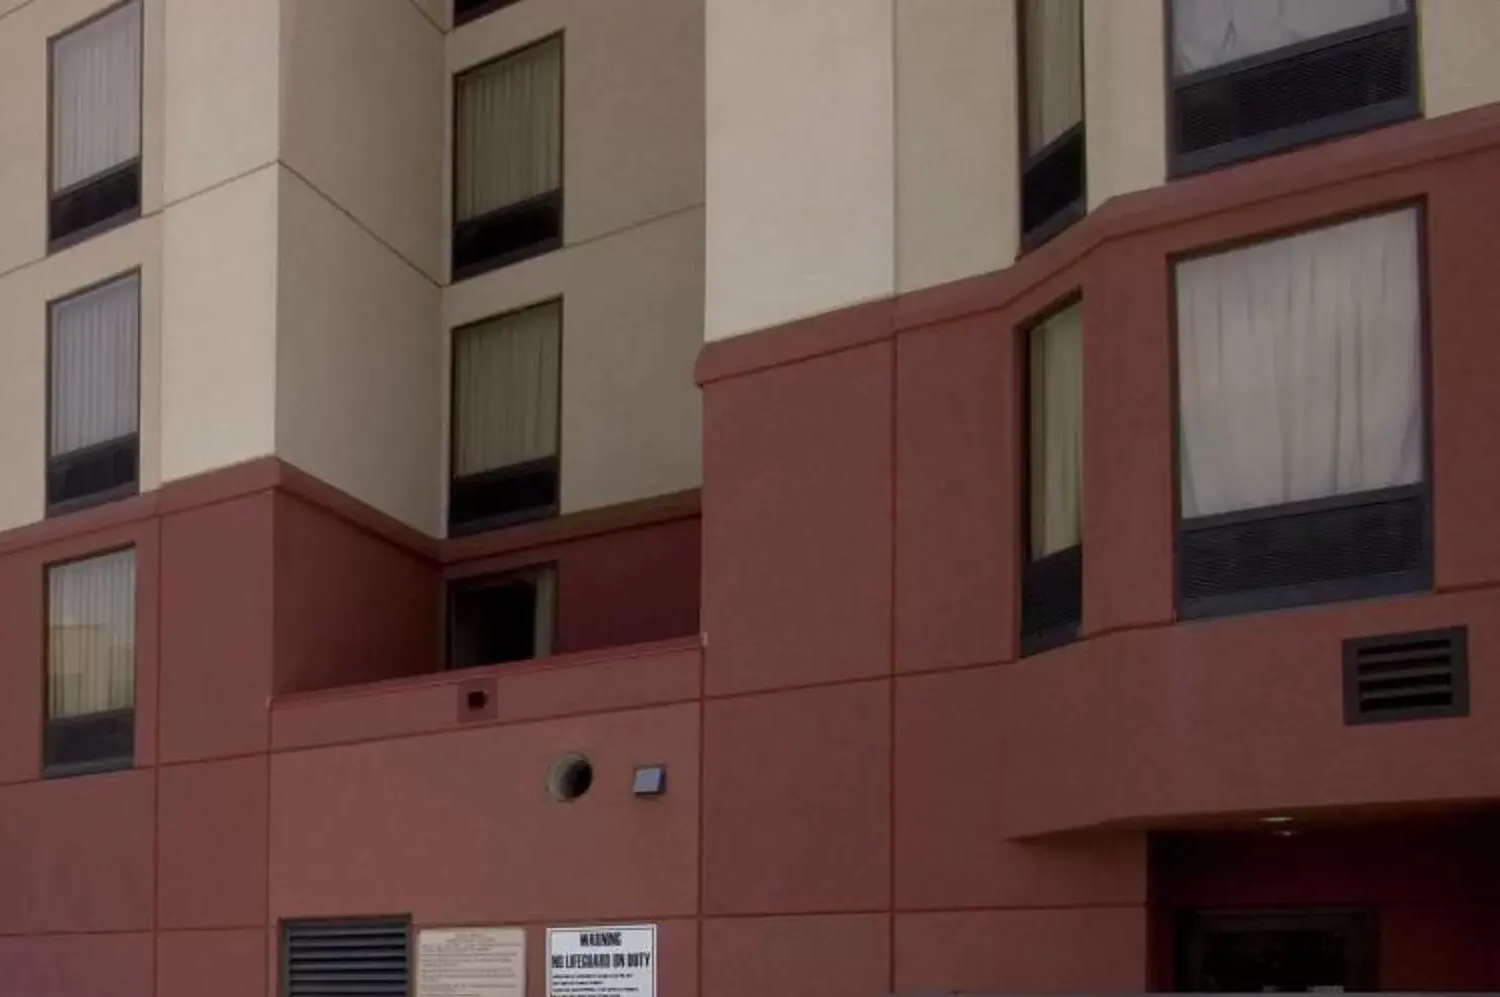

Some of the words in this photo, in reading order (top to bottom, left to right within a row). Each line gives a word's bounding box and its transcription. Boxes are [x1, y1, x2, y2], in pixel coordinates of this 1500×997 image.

[579, 931, 622, 947] WARNING
[552, 954, 564, 969] NO
[565, 952, 611, 969] LIFEGUARD
[612, 952, 625, 968] ON
[627, 951, 651, 968] DUTY
